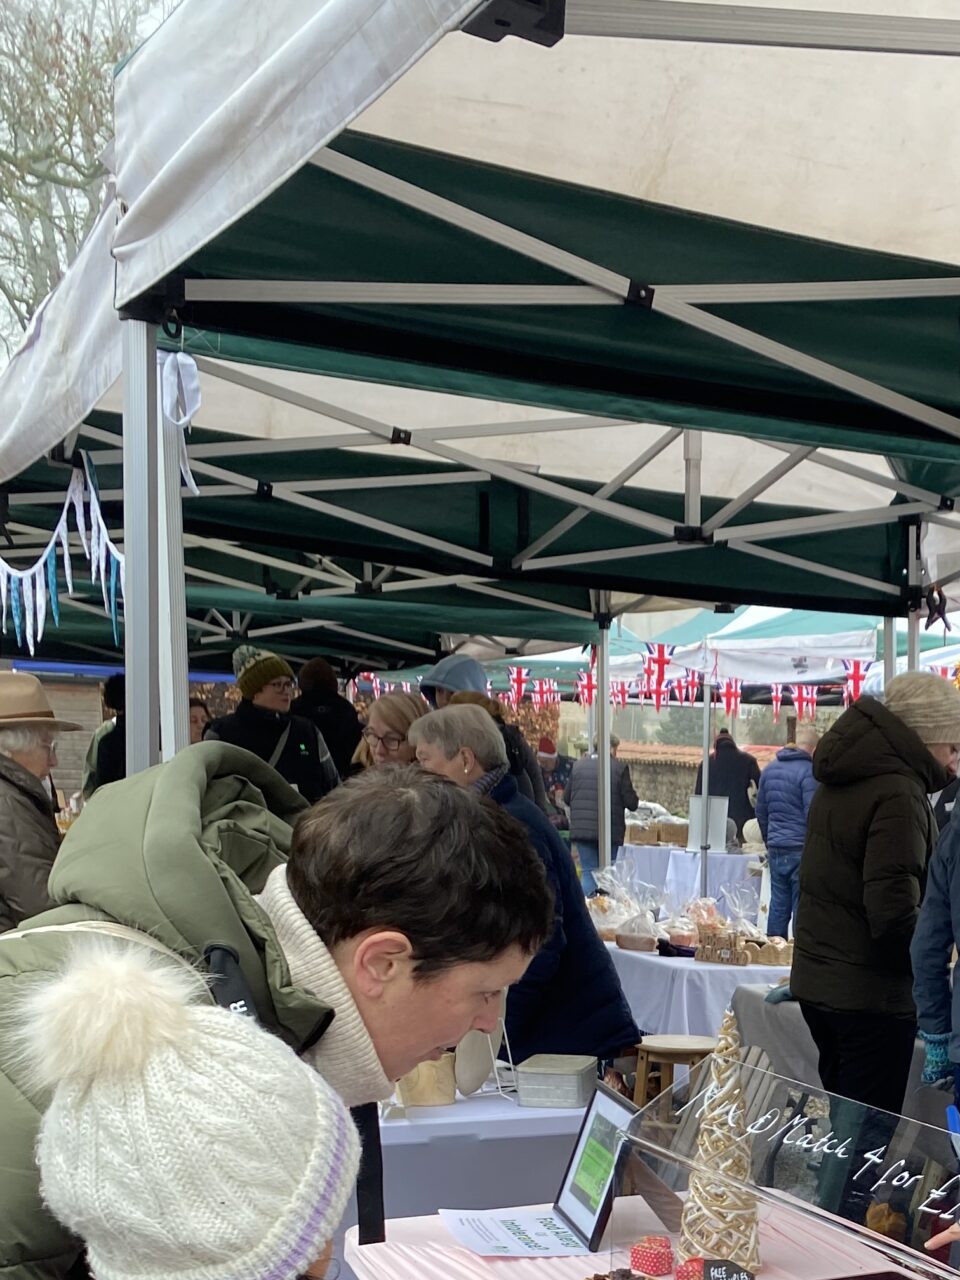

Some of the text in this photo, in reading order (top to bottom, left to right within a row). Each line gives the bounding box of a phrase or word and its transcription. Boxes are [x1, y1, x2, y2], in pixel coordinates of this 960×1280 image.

[768, 1114, 853, 1158] Match
[852, 1145, 887, 1181] 4
[870, 1159, 925, 1192] for
[710, 1266, 727, 1280] FREE
